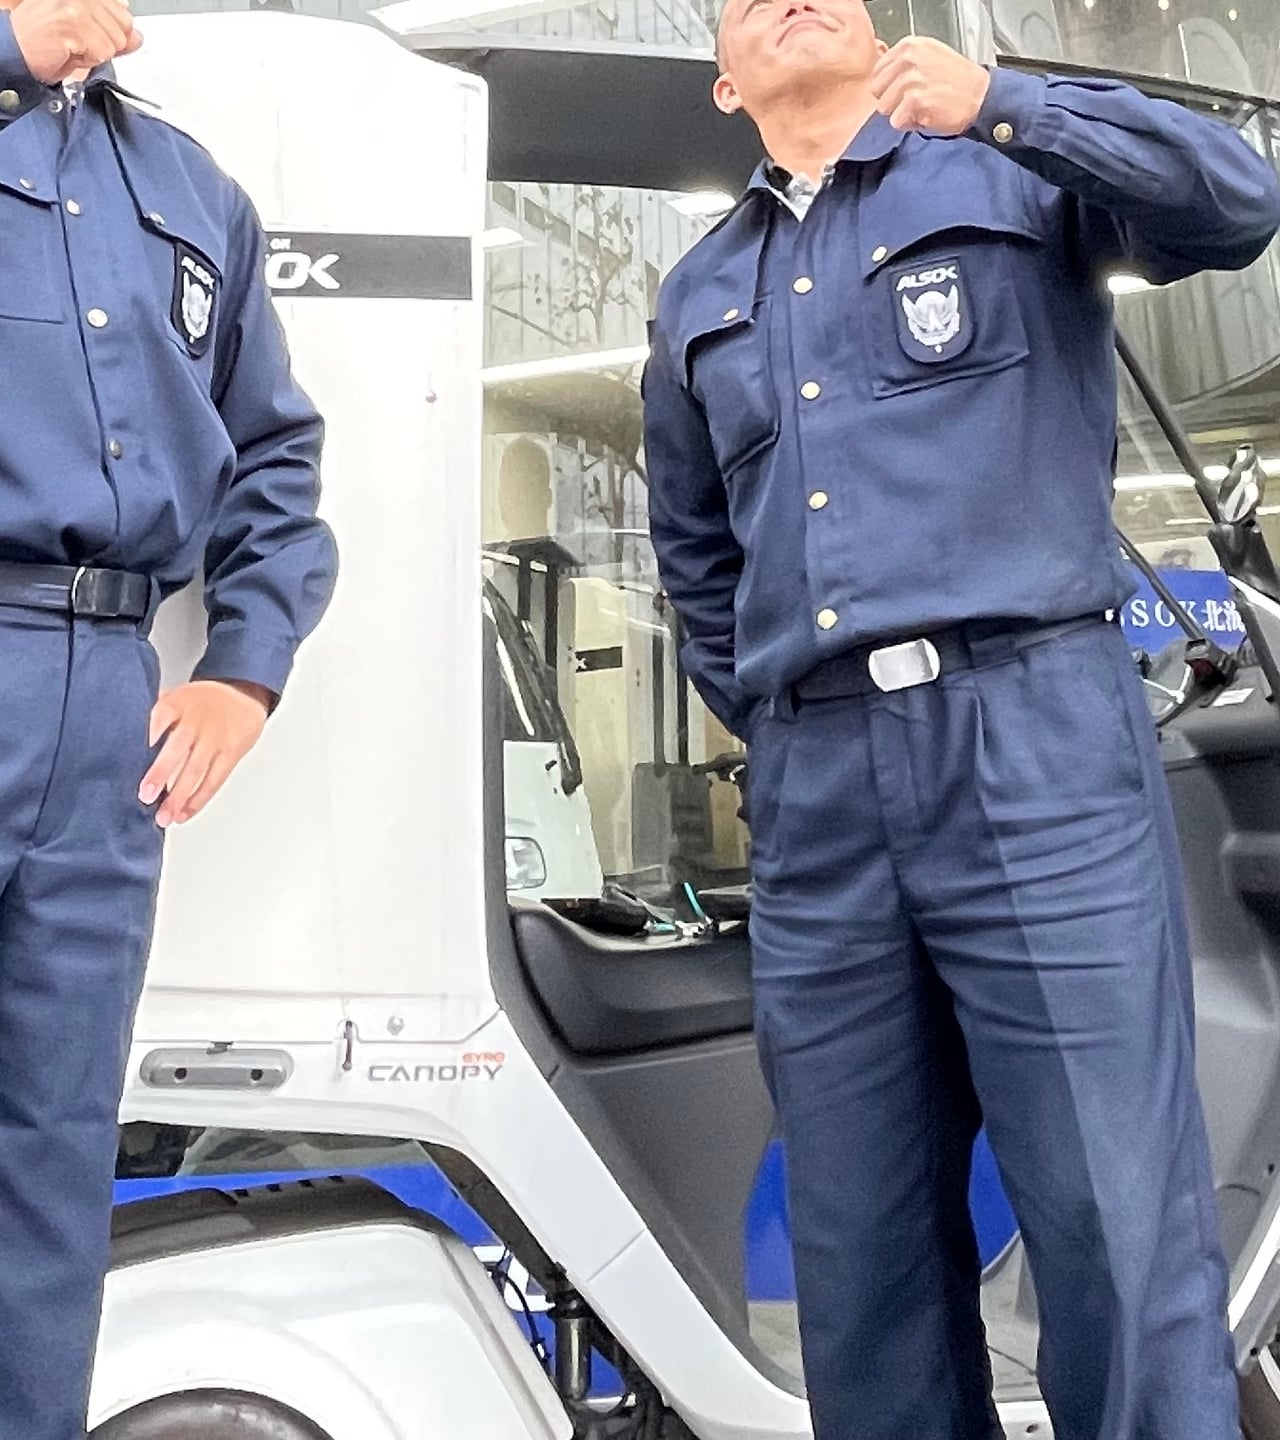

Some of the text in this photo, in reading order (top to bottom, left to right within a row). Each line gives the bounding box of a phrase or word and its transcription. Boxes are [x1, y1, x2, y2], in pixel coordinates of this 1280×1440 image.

[263, 251, 341, 290] OK
[895, 265, 959, 292] ALSOK
[367, 1064, 504, 1083] CANOPY
